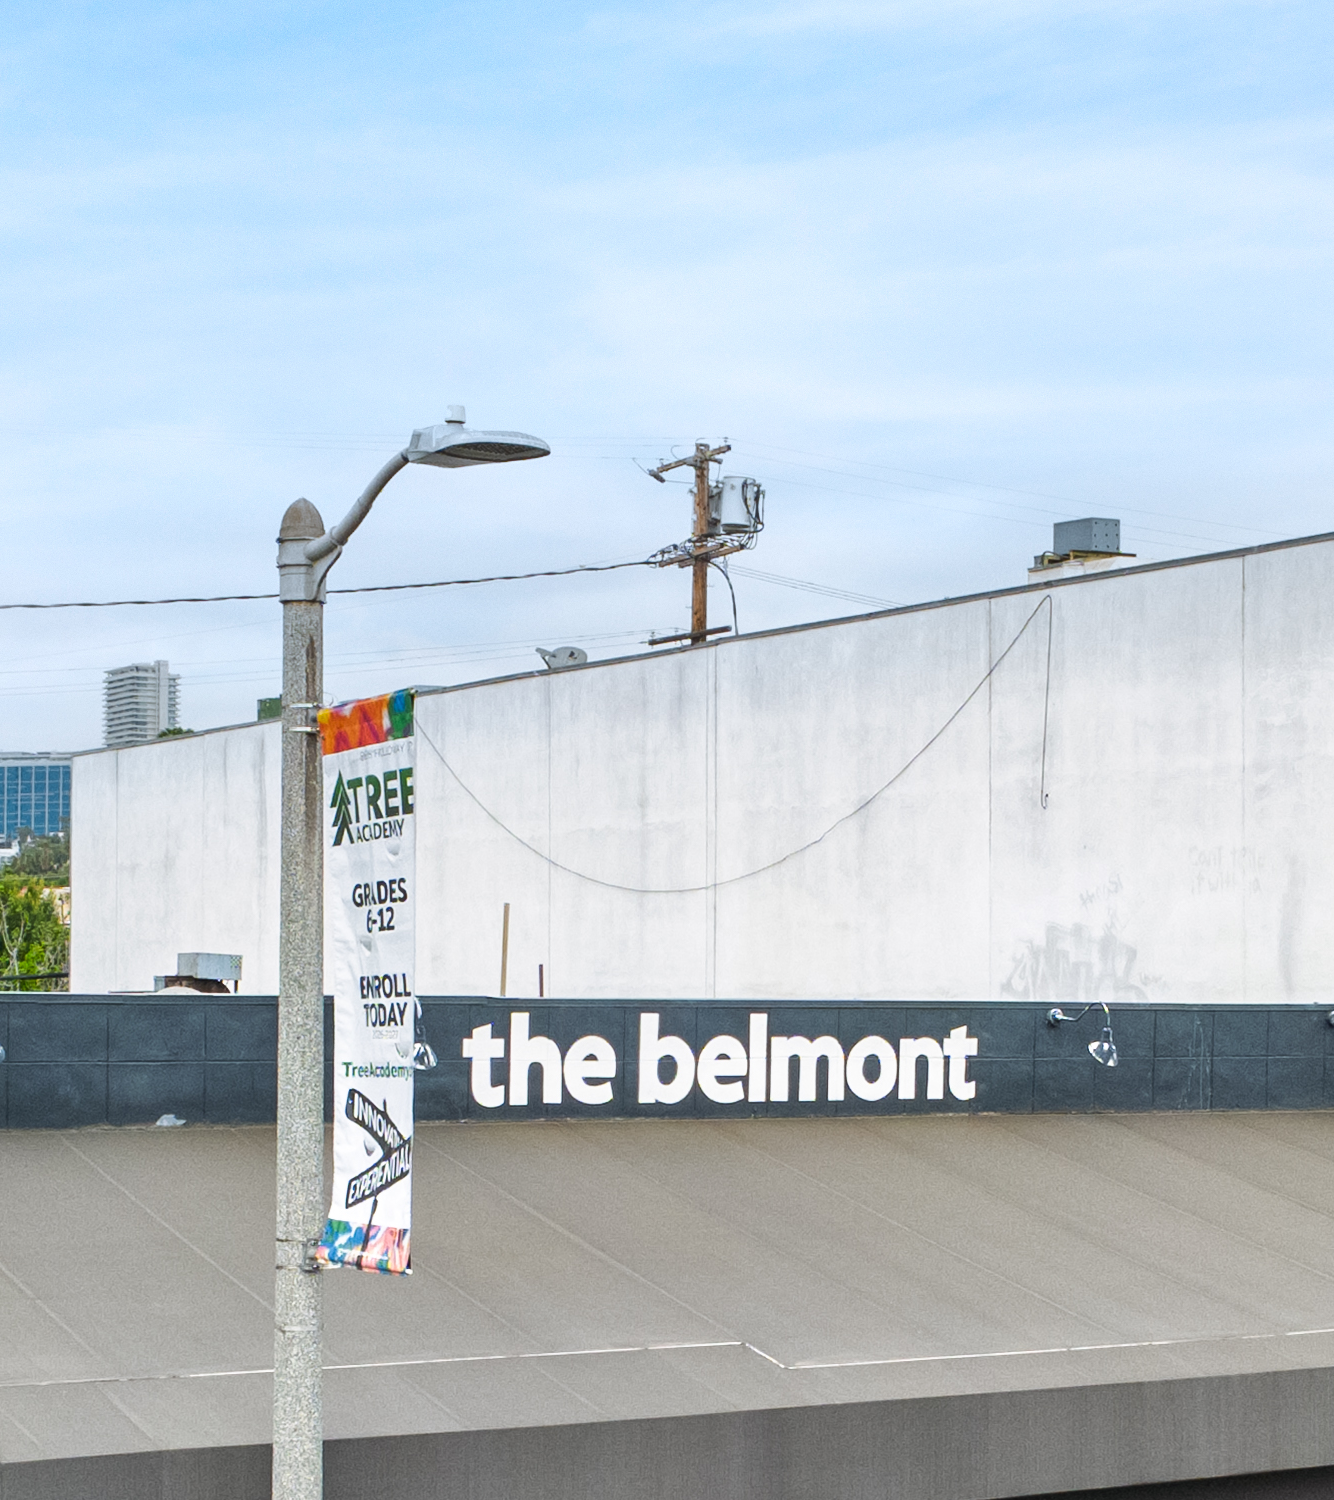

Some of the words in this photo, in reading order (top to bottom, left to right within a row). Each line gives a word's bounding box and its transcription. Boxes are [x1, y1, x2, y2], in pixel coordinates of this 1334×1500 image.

[347, 767, 414, 823] TREE
[356, 818, 405, 844] ACADEMY
[352, 878, 407, 908] GRADES
[367, 907, 395, 933] 6-12
[360, 973, 411, 999] ENROLL
[363, 1002, 407, 1027] TODAY
[462, 1012, 616, 1108] the
[638, 1012, 979, 1105] belmont
